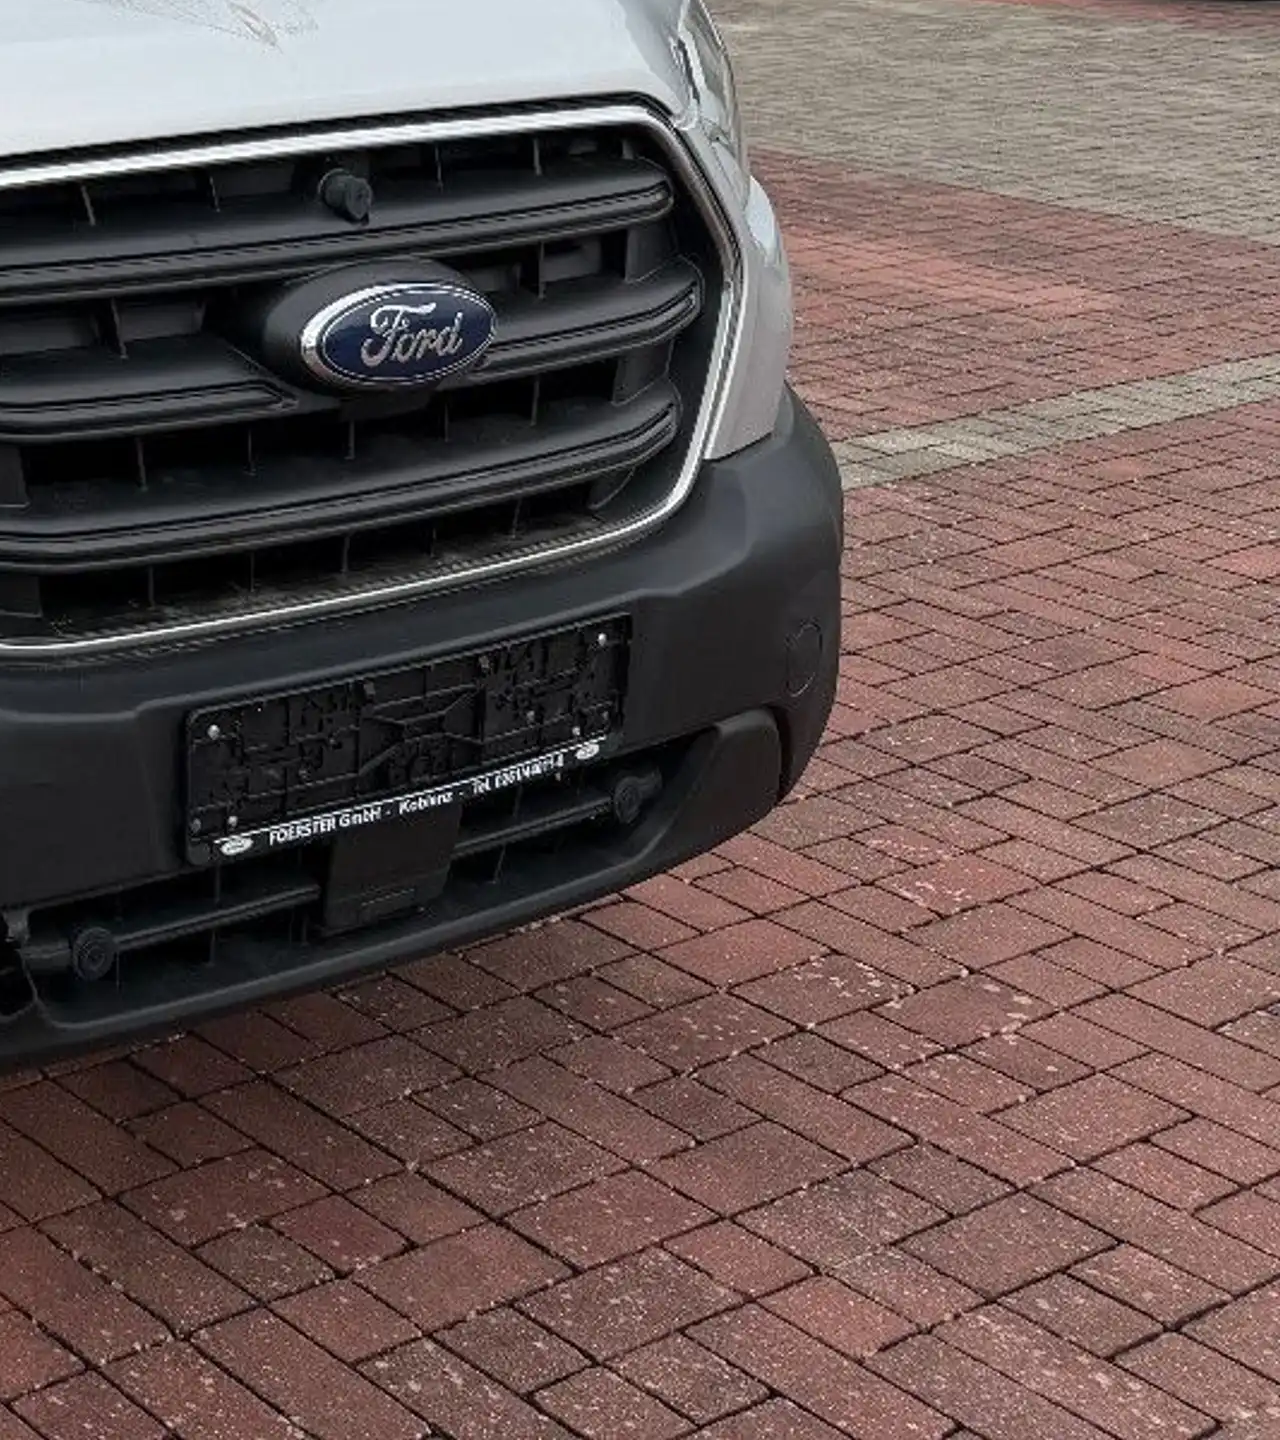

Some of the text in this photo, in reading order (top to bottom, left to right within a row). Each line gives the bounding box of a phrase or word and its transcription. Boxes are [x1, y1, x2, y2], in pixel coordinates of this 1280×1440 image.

[360, 301, 464, 368] Ford
[269, 817, 336, 846] FOERSTER
[338, 806, 382, 828] GmbH
[399, 792, 454, 815] Koblenz
